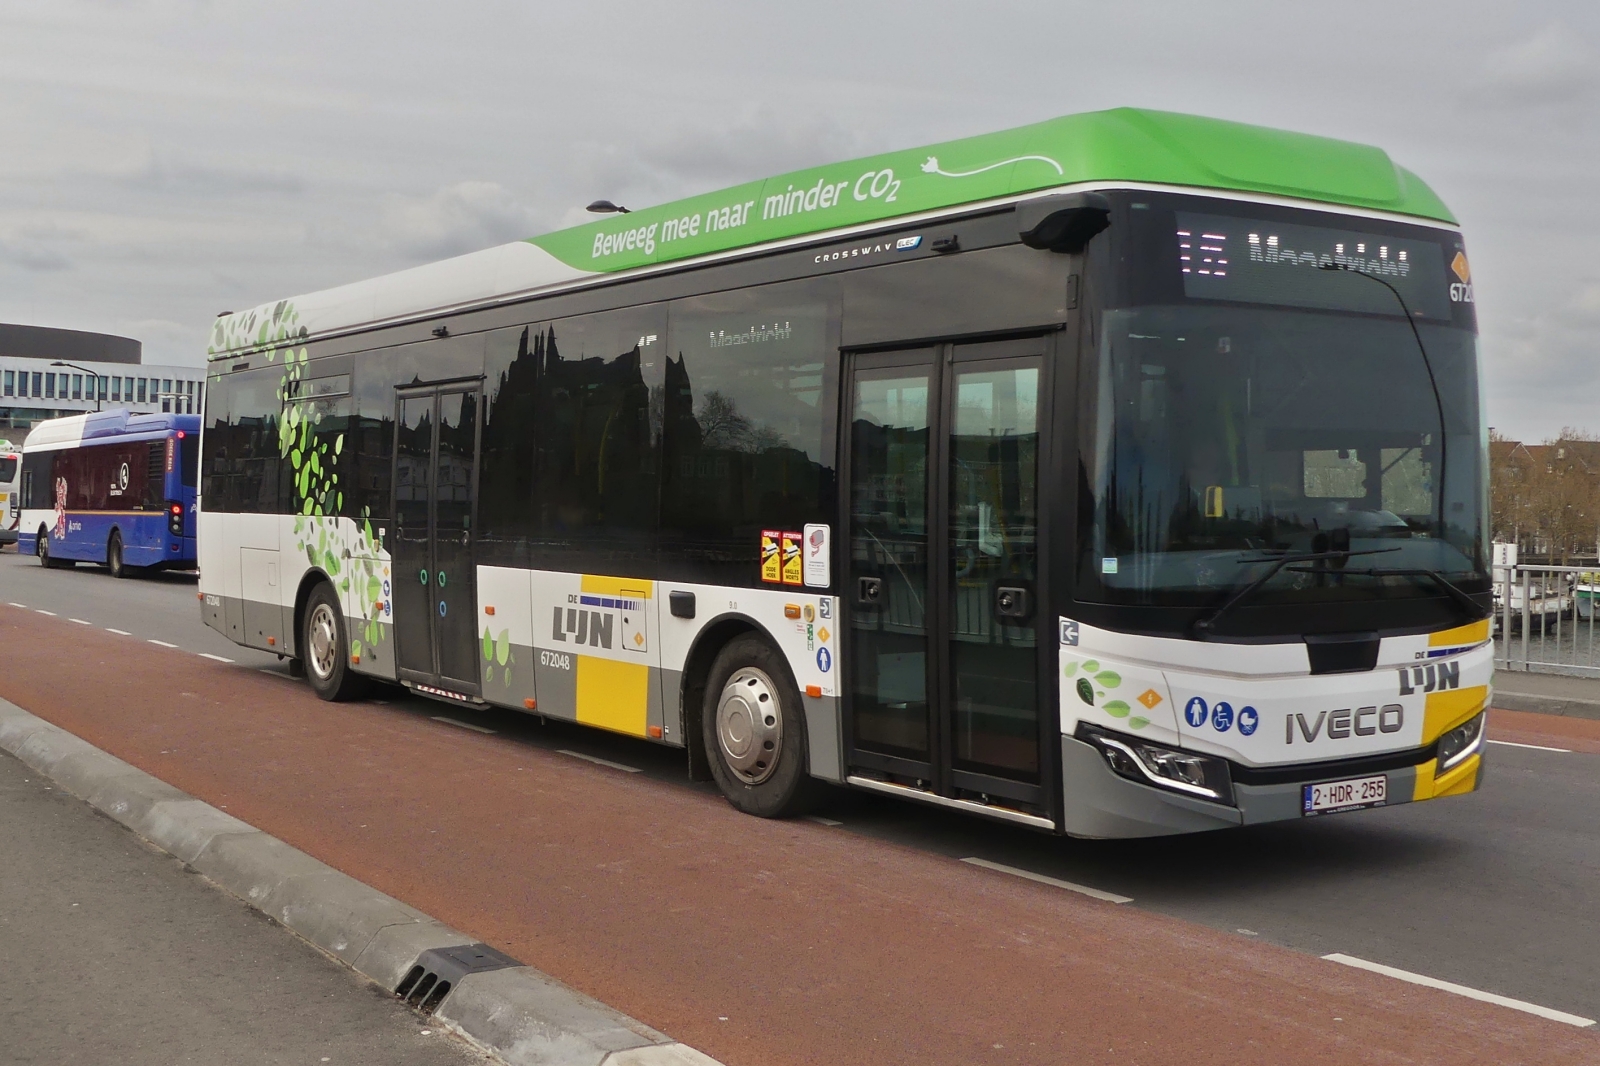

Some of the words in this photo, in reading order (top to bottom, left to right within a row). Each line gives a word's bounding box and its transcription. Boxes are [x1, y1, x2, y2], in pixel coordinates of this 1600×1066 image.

[591, 222, 659, 259] Beweeg
[661, 213, 701, 243] mee
[705, 199, 755, 233] naar
[762, 178, 849, 220] minder
[568, 594, 577, 604] DE
[552, 606, 613, 650] LIJN
[540, 651, 570, 671] 672048
[1415, 651, 1425, 660] DE
[1398, 661, 1459, 696] LIJN
[1285, 703, 1404, 745] IVECO
